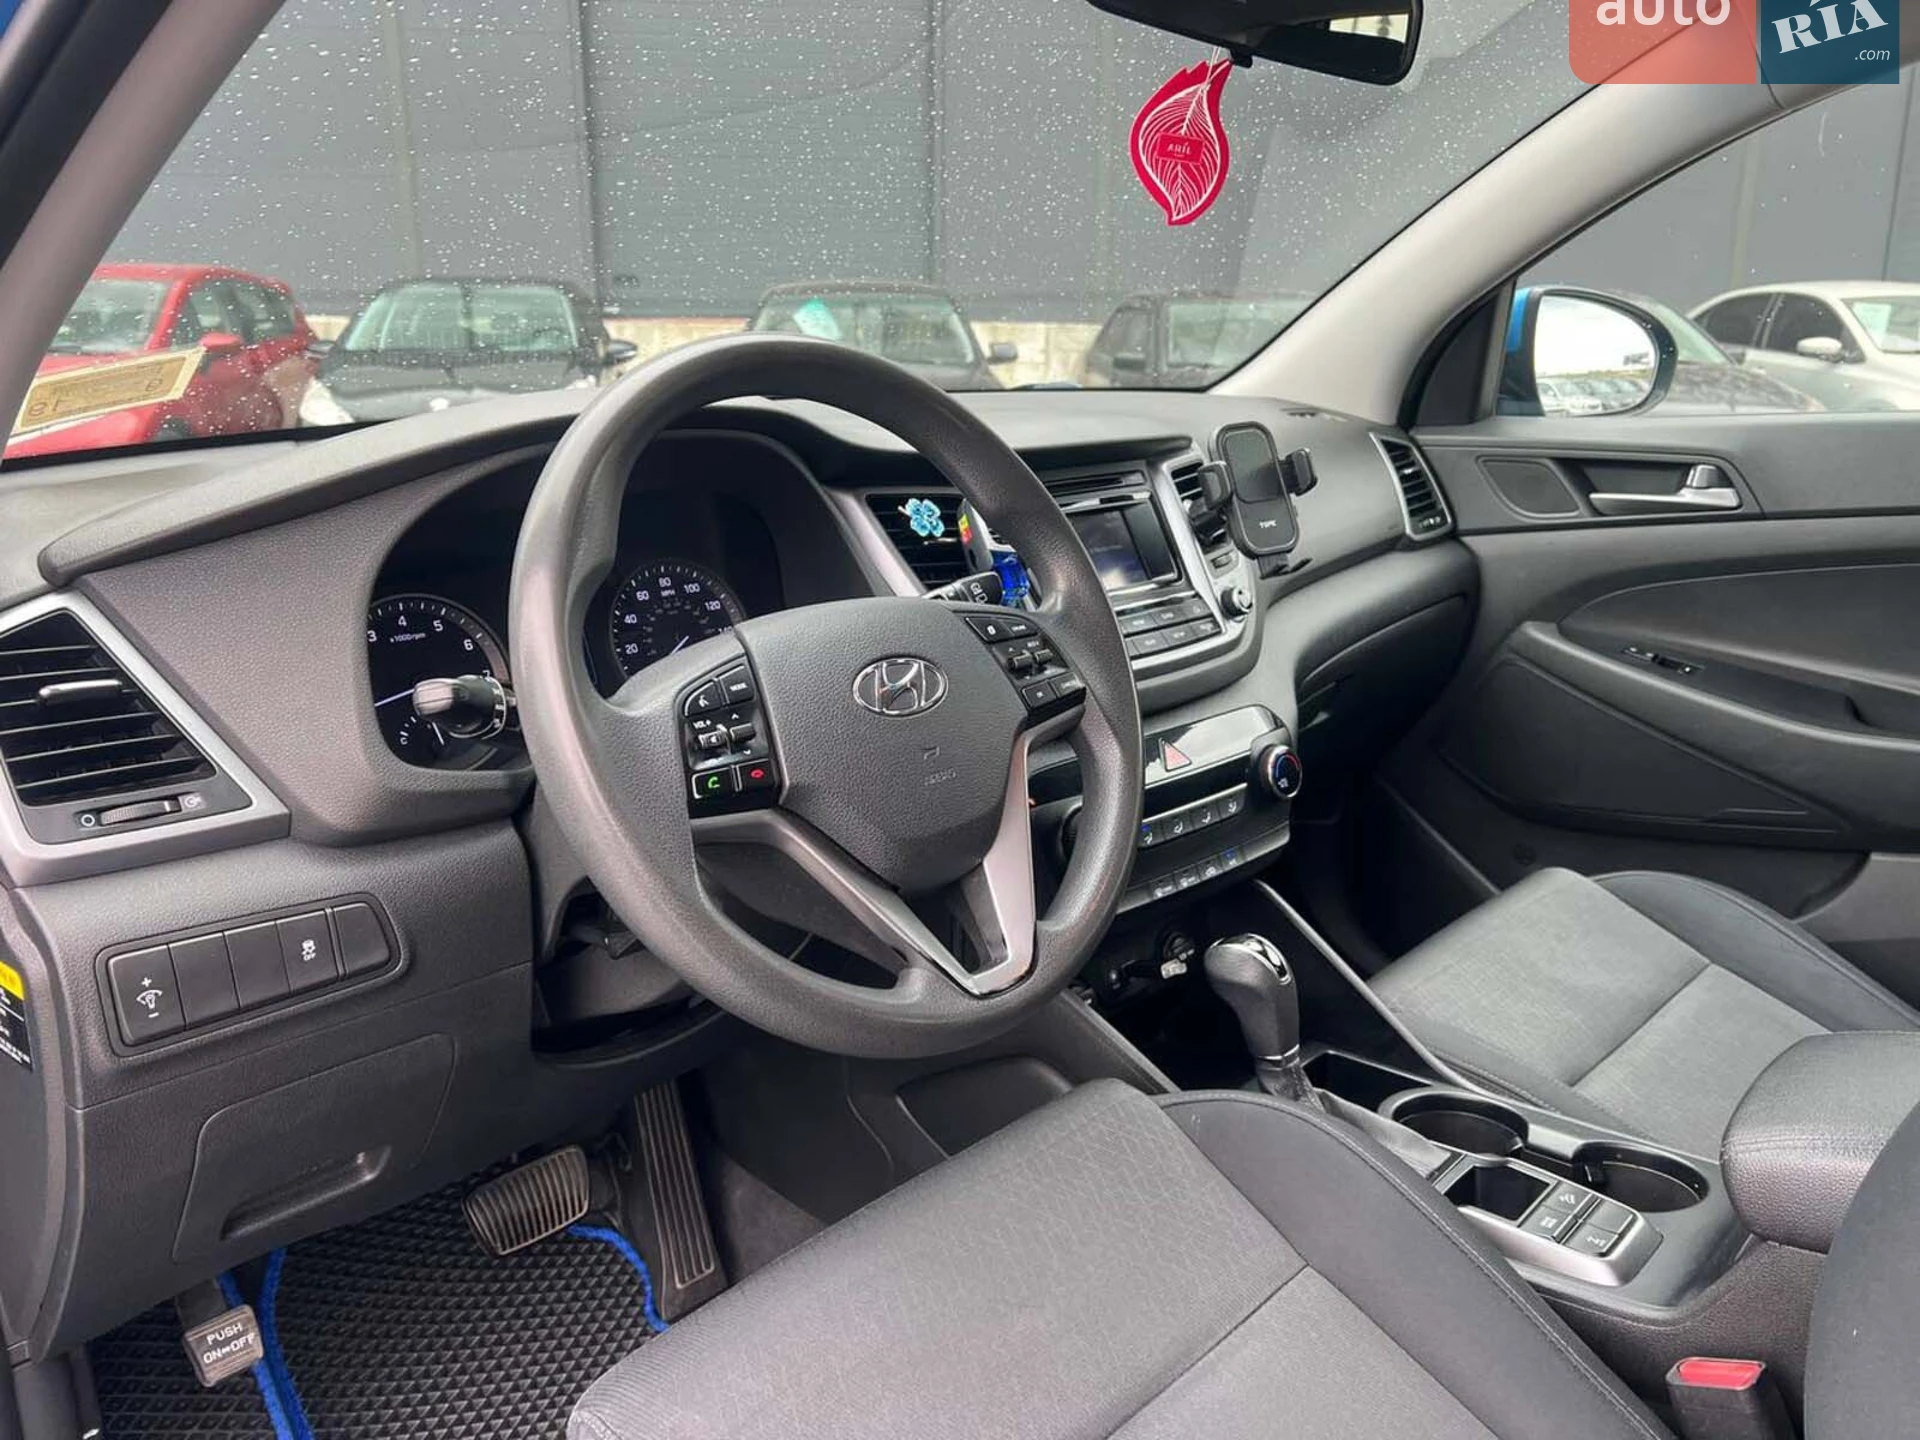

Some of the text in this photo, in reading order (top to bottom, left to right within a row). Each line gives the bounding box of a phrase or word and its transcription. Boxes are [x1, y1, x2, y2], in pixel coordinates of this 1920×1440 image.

[658, 576, 671, 587] 80
[684, 583, 701, 594] 100
[636, 590, 649, 601] 60
[704, 600, 721, 611] 120
[398, 615, 407, 627] 4
[624, 614, 637, 624] 40
[433, 620, 444, 632] 5
[367, 630, 377, 642] 3
[463, 639, 474, 651] 6
[625, 643, 638, 655] 20
[206, 1322, 243, 1345] PUSH
